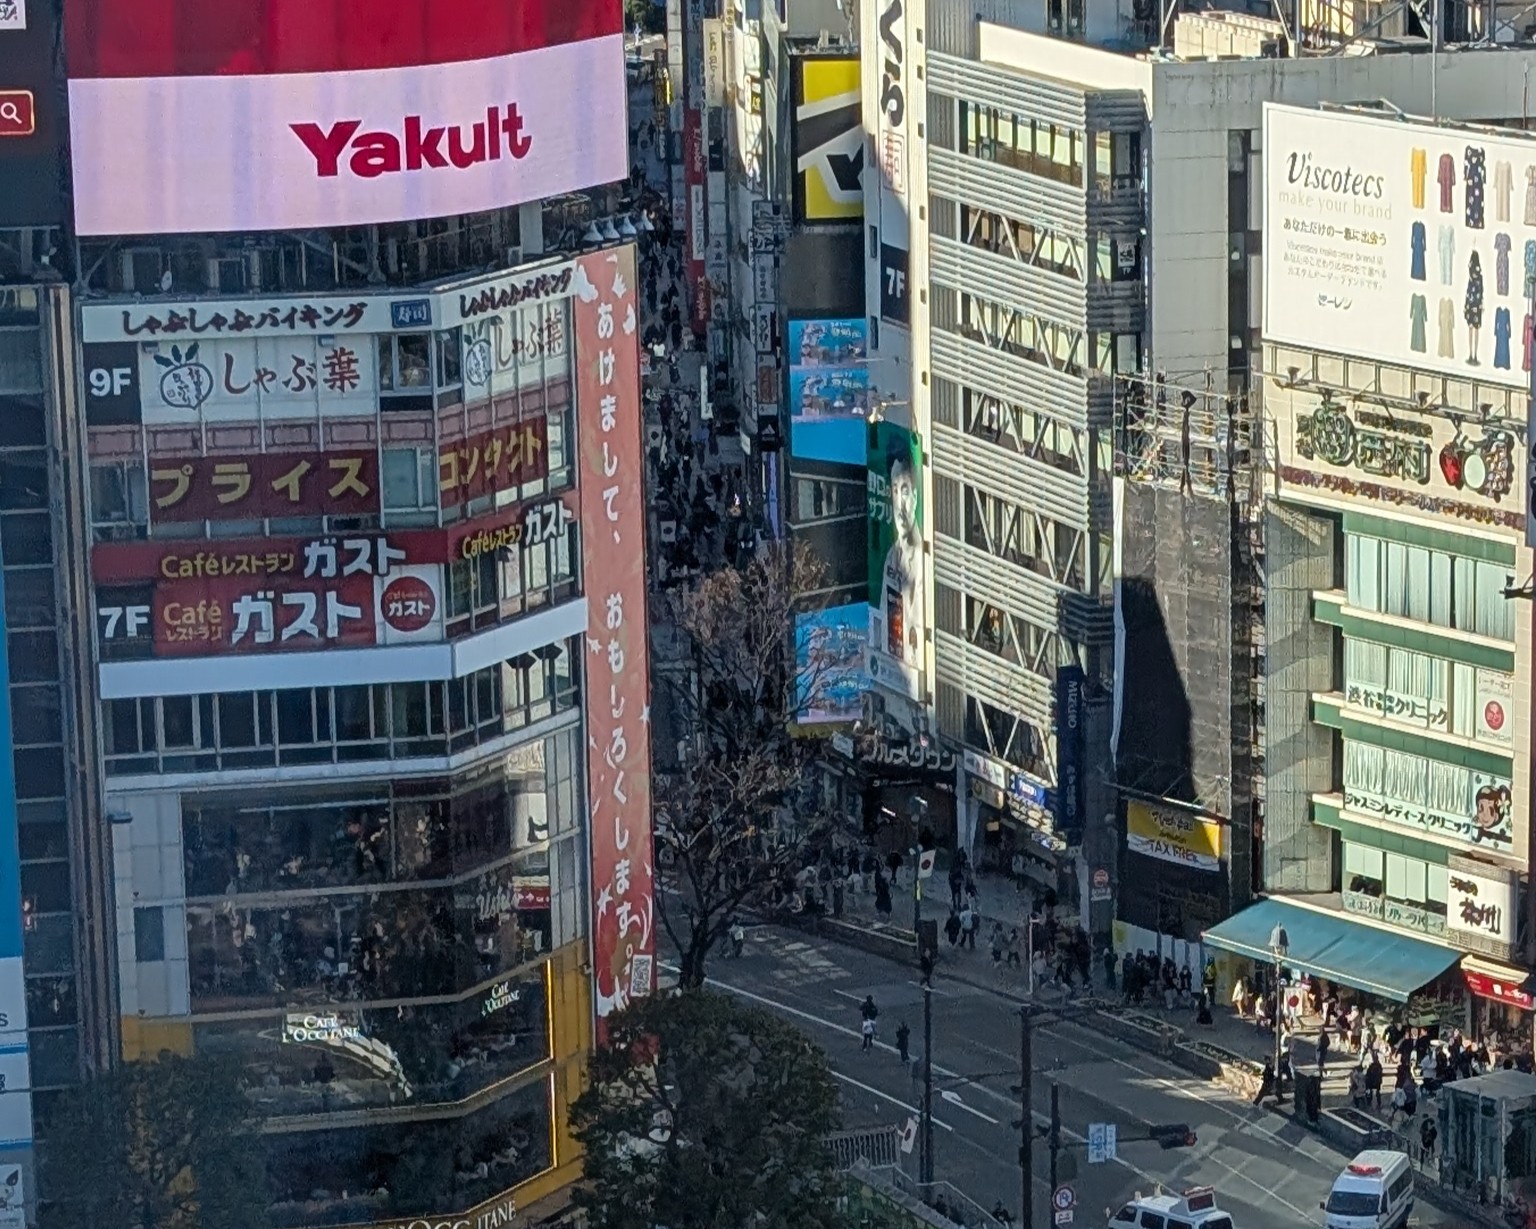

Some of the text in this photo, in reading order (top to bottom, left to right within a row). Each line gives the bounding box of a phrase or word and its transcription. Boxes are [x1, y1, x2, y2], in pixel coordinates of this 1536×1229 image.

[290, 103, 532, 178] Yakult
[1286, 152, 1385, 199] Viscotecs
[1279, 190, 1393, 220] make your brand
[460, 267, 573, 318] しゃぶしゃぶバイキング
[886, 266, 906, 298] 7F
[122, 301, 368, 335] しゃぶしゃぶバイキング
[89, 366, 132, 398] 9F
[224, 346, 361, 395] しゃぶ葉
[595, 302, 625, 545] あけまして、
[439, 426, 541, 492] コンタクト
[150, 456, 370, 509] プライス
[525, 499, 573, 546] ガスト
[303, 537, 407, 579] ガスト
[100, 605, 150, 640] 7F
[163, 599, 222, 626] Café
[231, 589, 363, 645] ガスト
[387, 599, 430, 618] ガスト
[166, 626, 223, 642] レストラン
